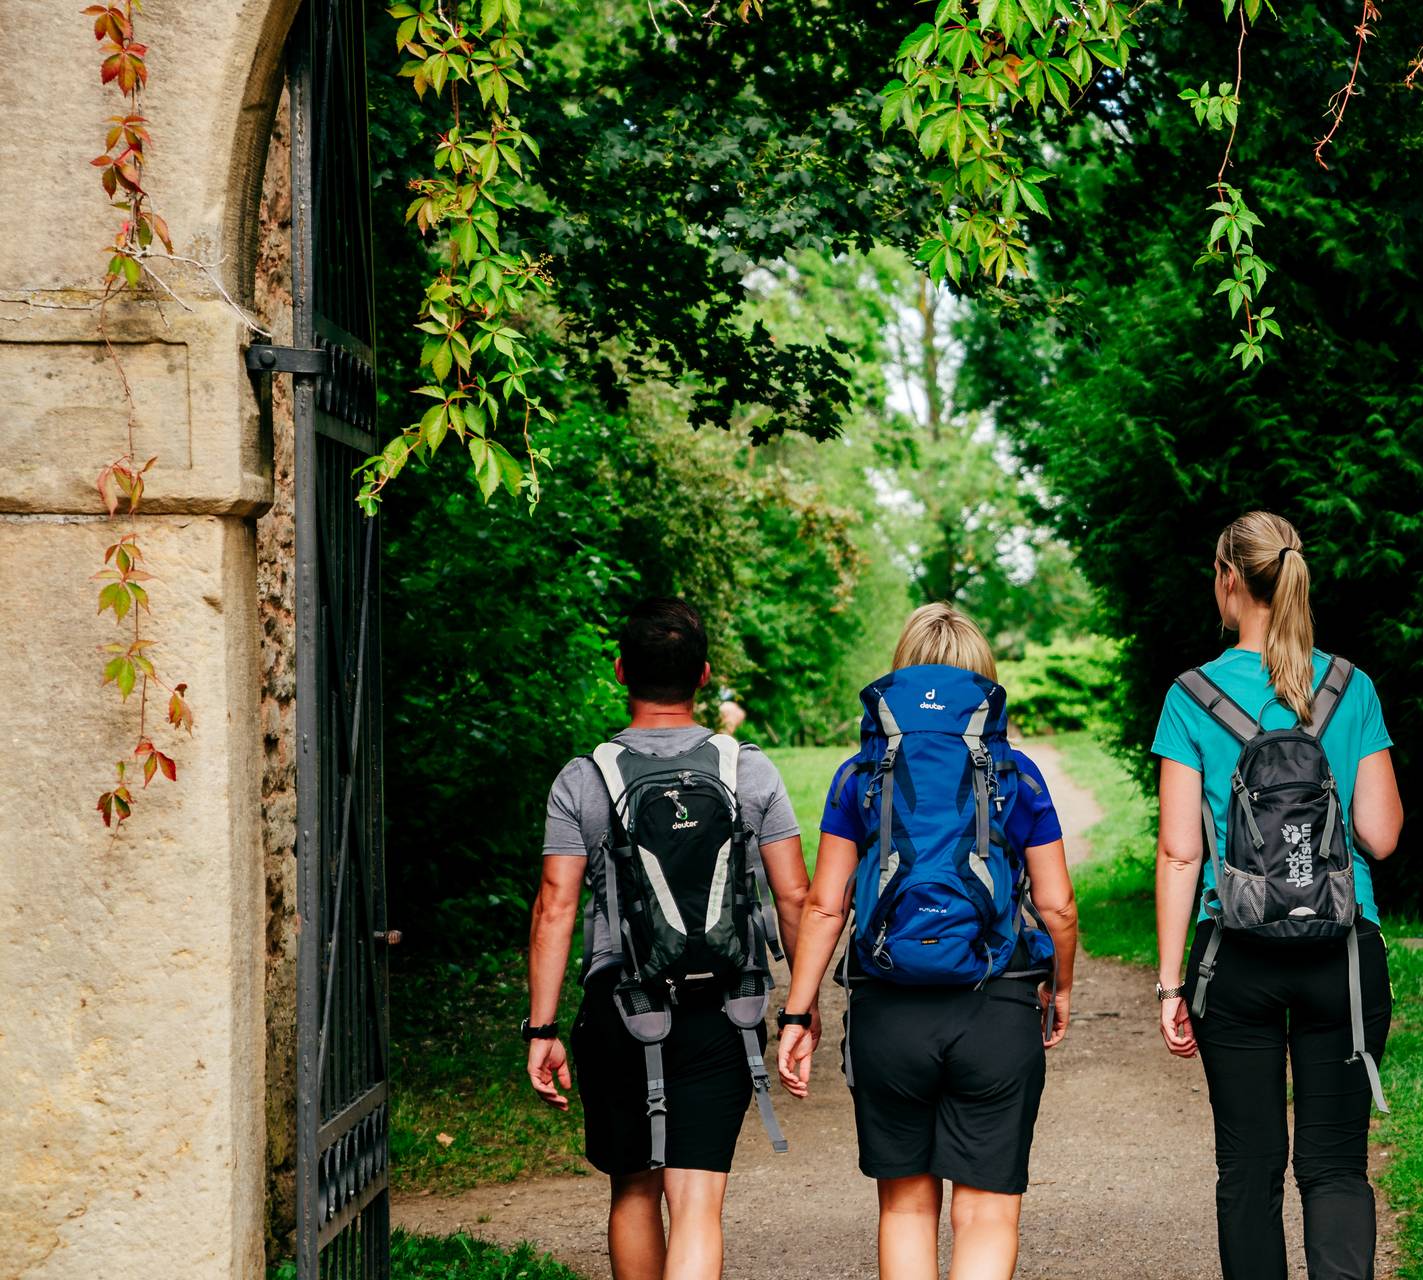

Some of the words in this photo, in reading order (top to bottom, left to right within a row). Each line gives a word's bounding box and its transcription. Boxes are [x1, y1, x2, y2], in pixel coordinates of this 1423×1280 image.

[919, 701, 946, 711] deuter
[672, 820, 699, 830] deuter
[1299, 823, 1313, 888] Wolfskin
[1285, 850, 1300, 888] Jack
